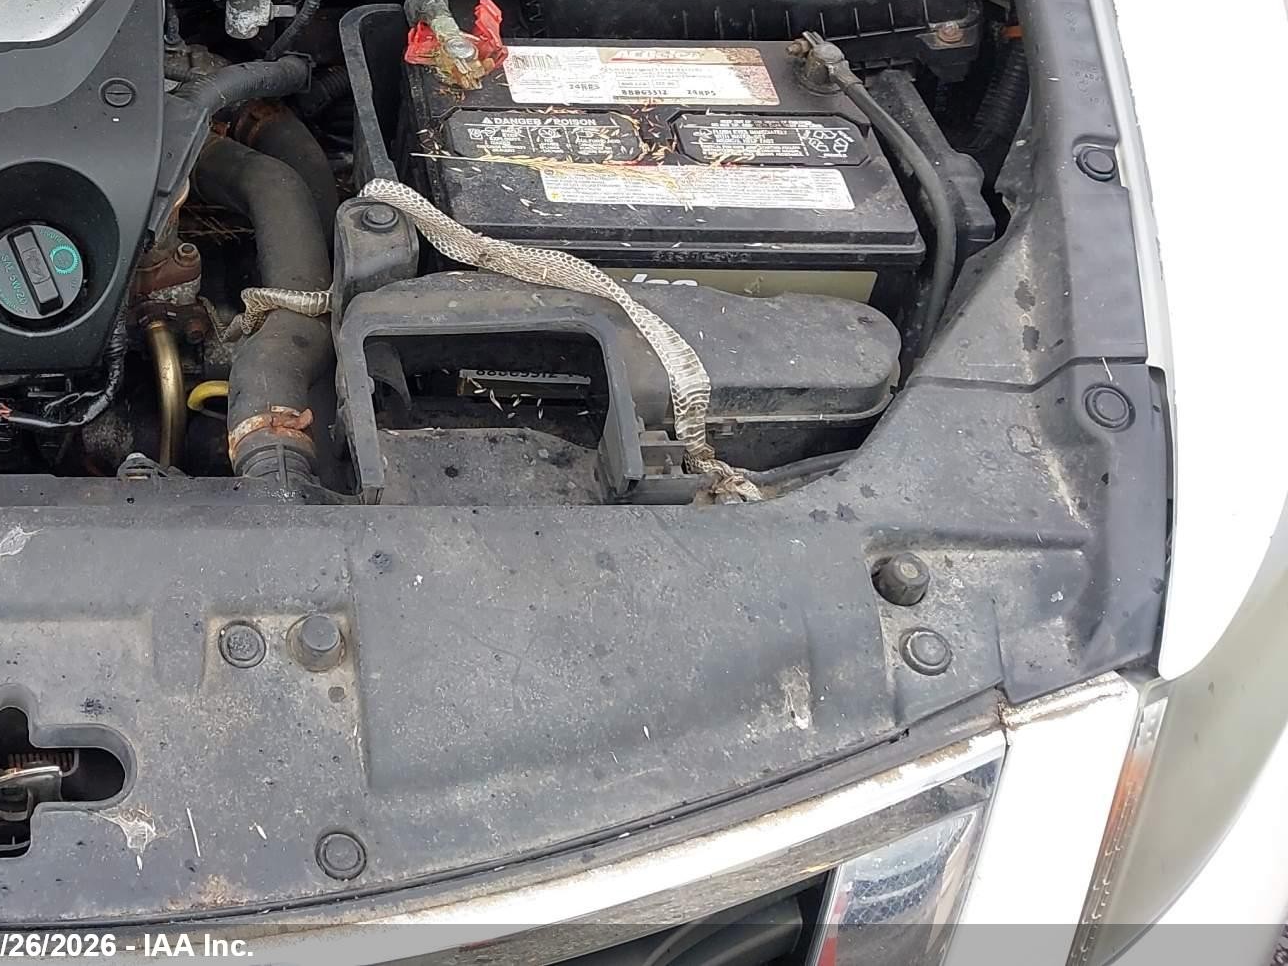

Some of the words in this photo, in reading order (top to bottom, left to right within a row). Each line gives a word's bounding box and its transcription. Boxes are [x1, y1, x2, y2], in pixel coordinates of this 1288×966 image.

[494, 117, 541, 126] DANGER
[554, 118, 597, 127] POISON
[9, 275, 28, 306] 5W-20
